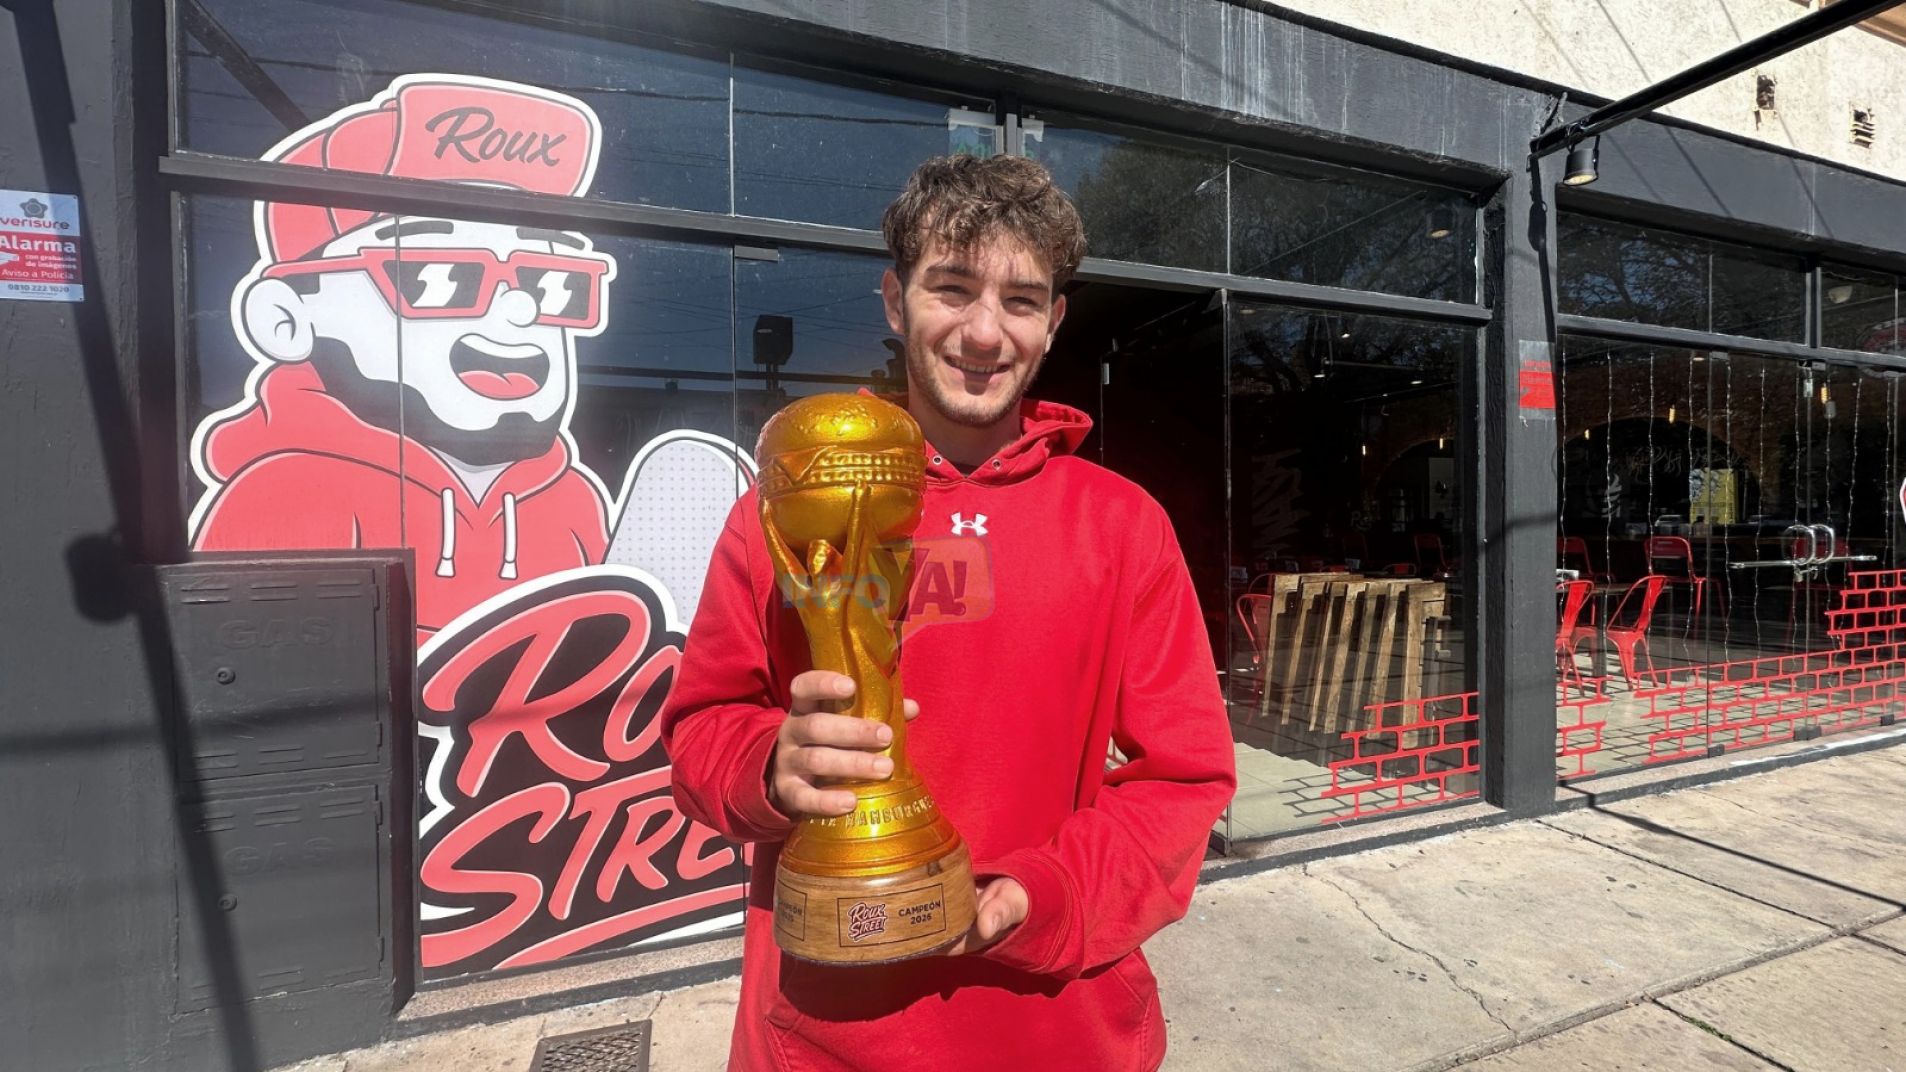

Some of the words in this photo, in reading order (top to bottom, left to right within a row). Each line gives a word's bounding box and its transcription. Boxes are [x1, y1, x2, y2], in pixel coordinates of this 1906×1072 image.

[425, 107, 567, 167] Roux
[0, 217, 70, 229] verisure
[0, 235, 76, 253] Alarma
[1, 268, 29, 277] Aviso
[217, 617, 336, 649] GAS
[422, 589, 686, 798] Ro
[420, 765, 754, 968] STRE
[849, 917, 887, 937] STREET
[910, 912, 932, 925] 2026
